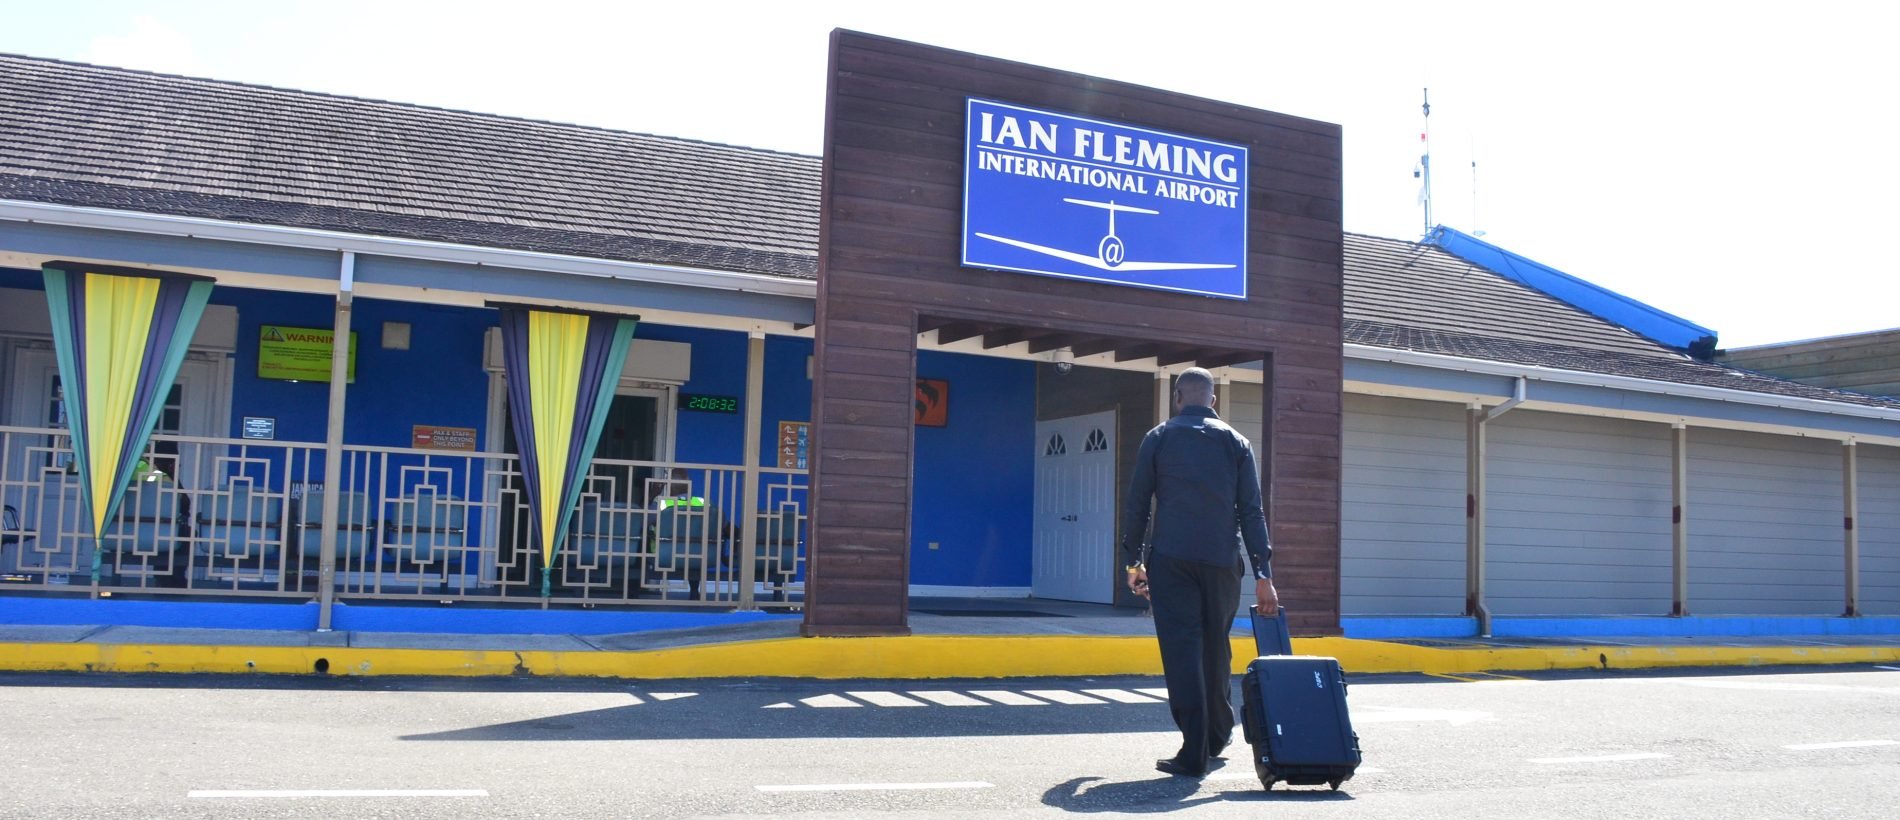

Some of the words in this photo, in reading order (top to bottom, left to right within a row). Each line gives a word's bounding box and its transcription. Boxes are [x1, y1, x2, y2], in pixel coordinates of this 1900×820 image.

[980, 112, 1058, 154] IAN
[1074, 128, 1237, 183] FLEMING
[978, 151, 1148, 195] INTERNATIONAL
[1155, 179, 1239, 208] AIRPORT
[286, 333, 335, 344] WARNIN
[689, 396, 737, 411] 2:08:32
